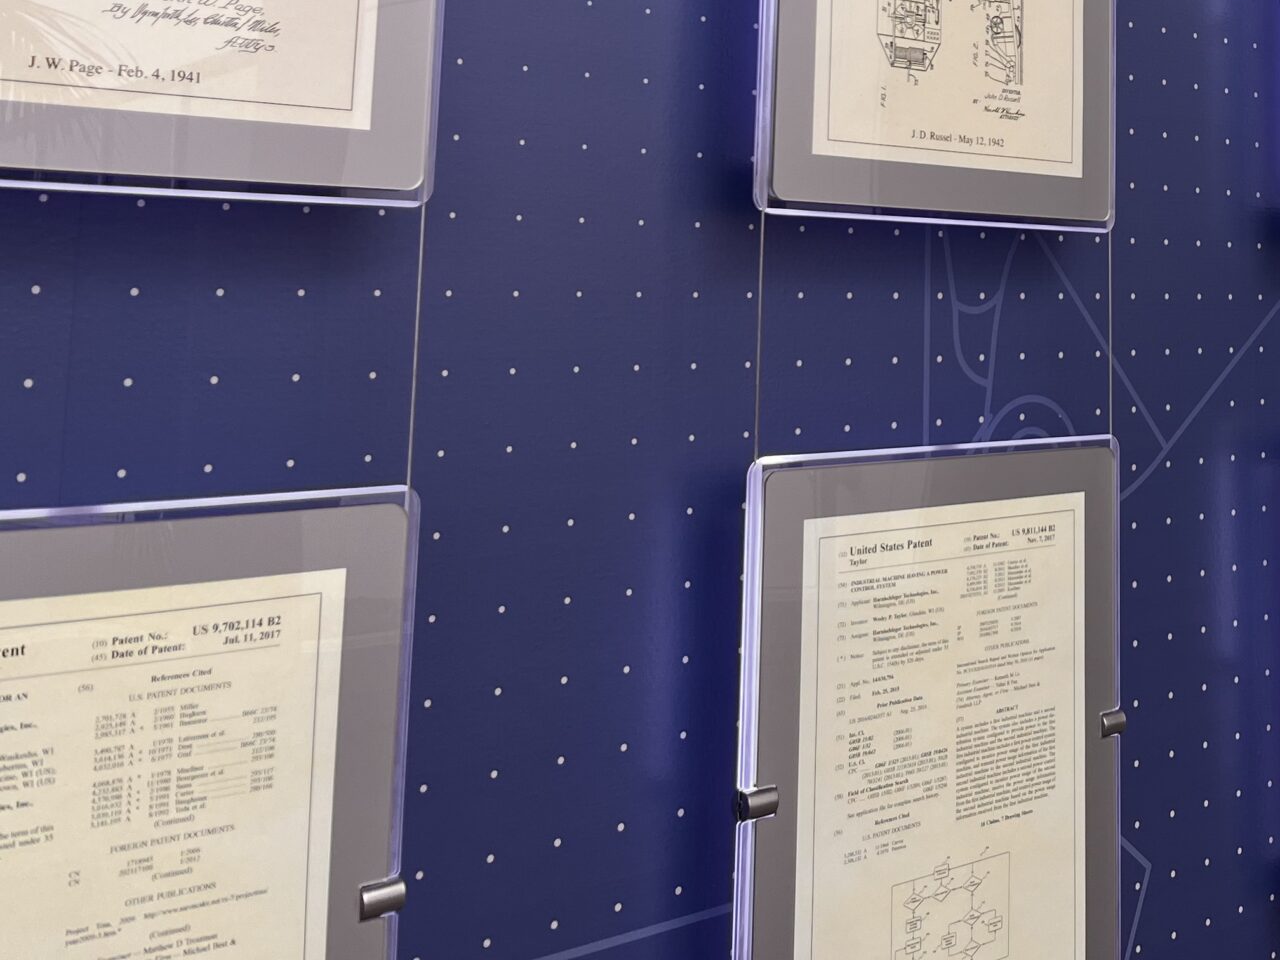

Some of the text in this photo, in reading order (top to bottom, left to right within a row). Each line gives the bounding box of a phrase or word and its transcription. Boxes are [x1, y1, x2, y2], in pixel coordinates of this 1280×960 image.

[102, 2, 131, 19] By
[28, 55, 41, 69] J.
[45, 56, 65, 71] W.
[69, 59, 104, 77] Page
[117, 63, 148, 79] Feb.
[151, 68, 165, 82] 4,
[169, 69, 201, 84] 1941
[930, 131, 952, 142] Russel
[959, 135, 973, 146] May
[976, 136, 986, 146] 12,
[988, 138, 1004, 147] 1942
[973, 533, 988, 542] Patent
[1011, 529, 1020, 537] US
[850, 538, 933, 557] United States Patent
[972, 543, 984, 551] Date
[850, 558, 868, 567] Taylor
[882, 574, 905, 582] MACHINE
[876, 582, 896, 590] SYSTEM
[112, 634, 143, 646] Patent
[148, 631, 168, 642] No.:
[192, 625, 208, 637] US
[212, 618, 263, 634] 9,702,114
[267, 615, 281, 626] B2
[0, 644, 25, 658] ent
[111, 647, 134, 660] Date
[137, 645, 148, 656] of
[151, 642, 185, 655] Patent:
[223, 635, 240, 646] Jul.
[243, 632, 257, 643] 11,
[259, 629, 281, 640] 2017
[151, 668, 212, 683] References Cited
[147, 687, 178, 700] PATENT
[180, 681, 232, 695] DOCUMENTS
[889, 698, 912, 706] Publication
[154, 814, 195, 828] (Continued)
[110, 824, 235, 855] FOREIGN PATENT DOCUMENTS
[151, 867, 193, 882] (Continued)
[124, 882, 217, 908] OTHER PUBLICATIONS
[149, 924, 191, 940] (Continued)
